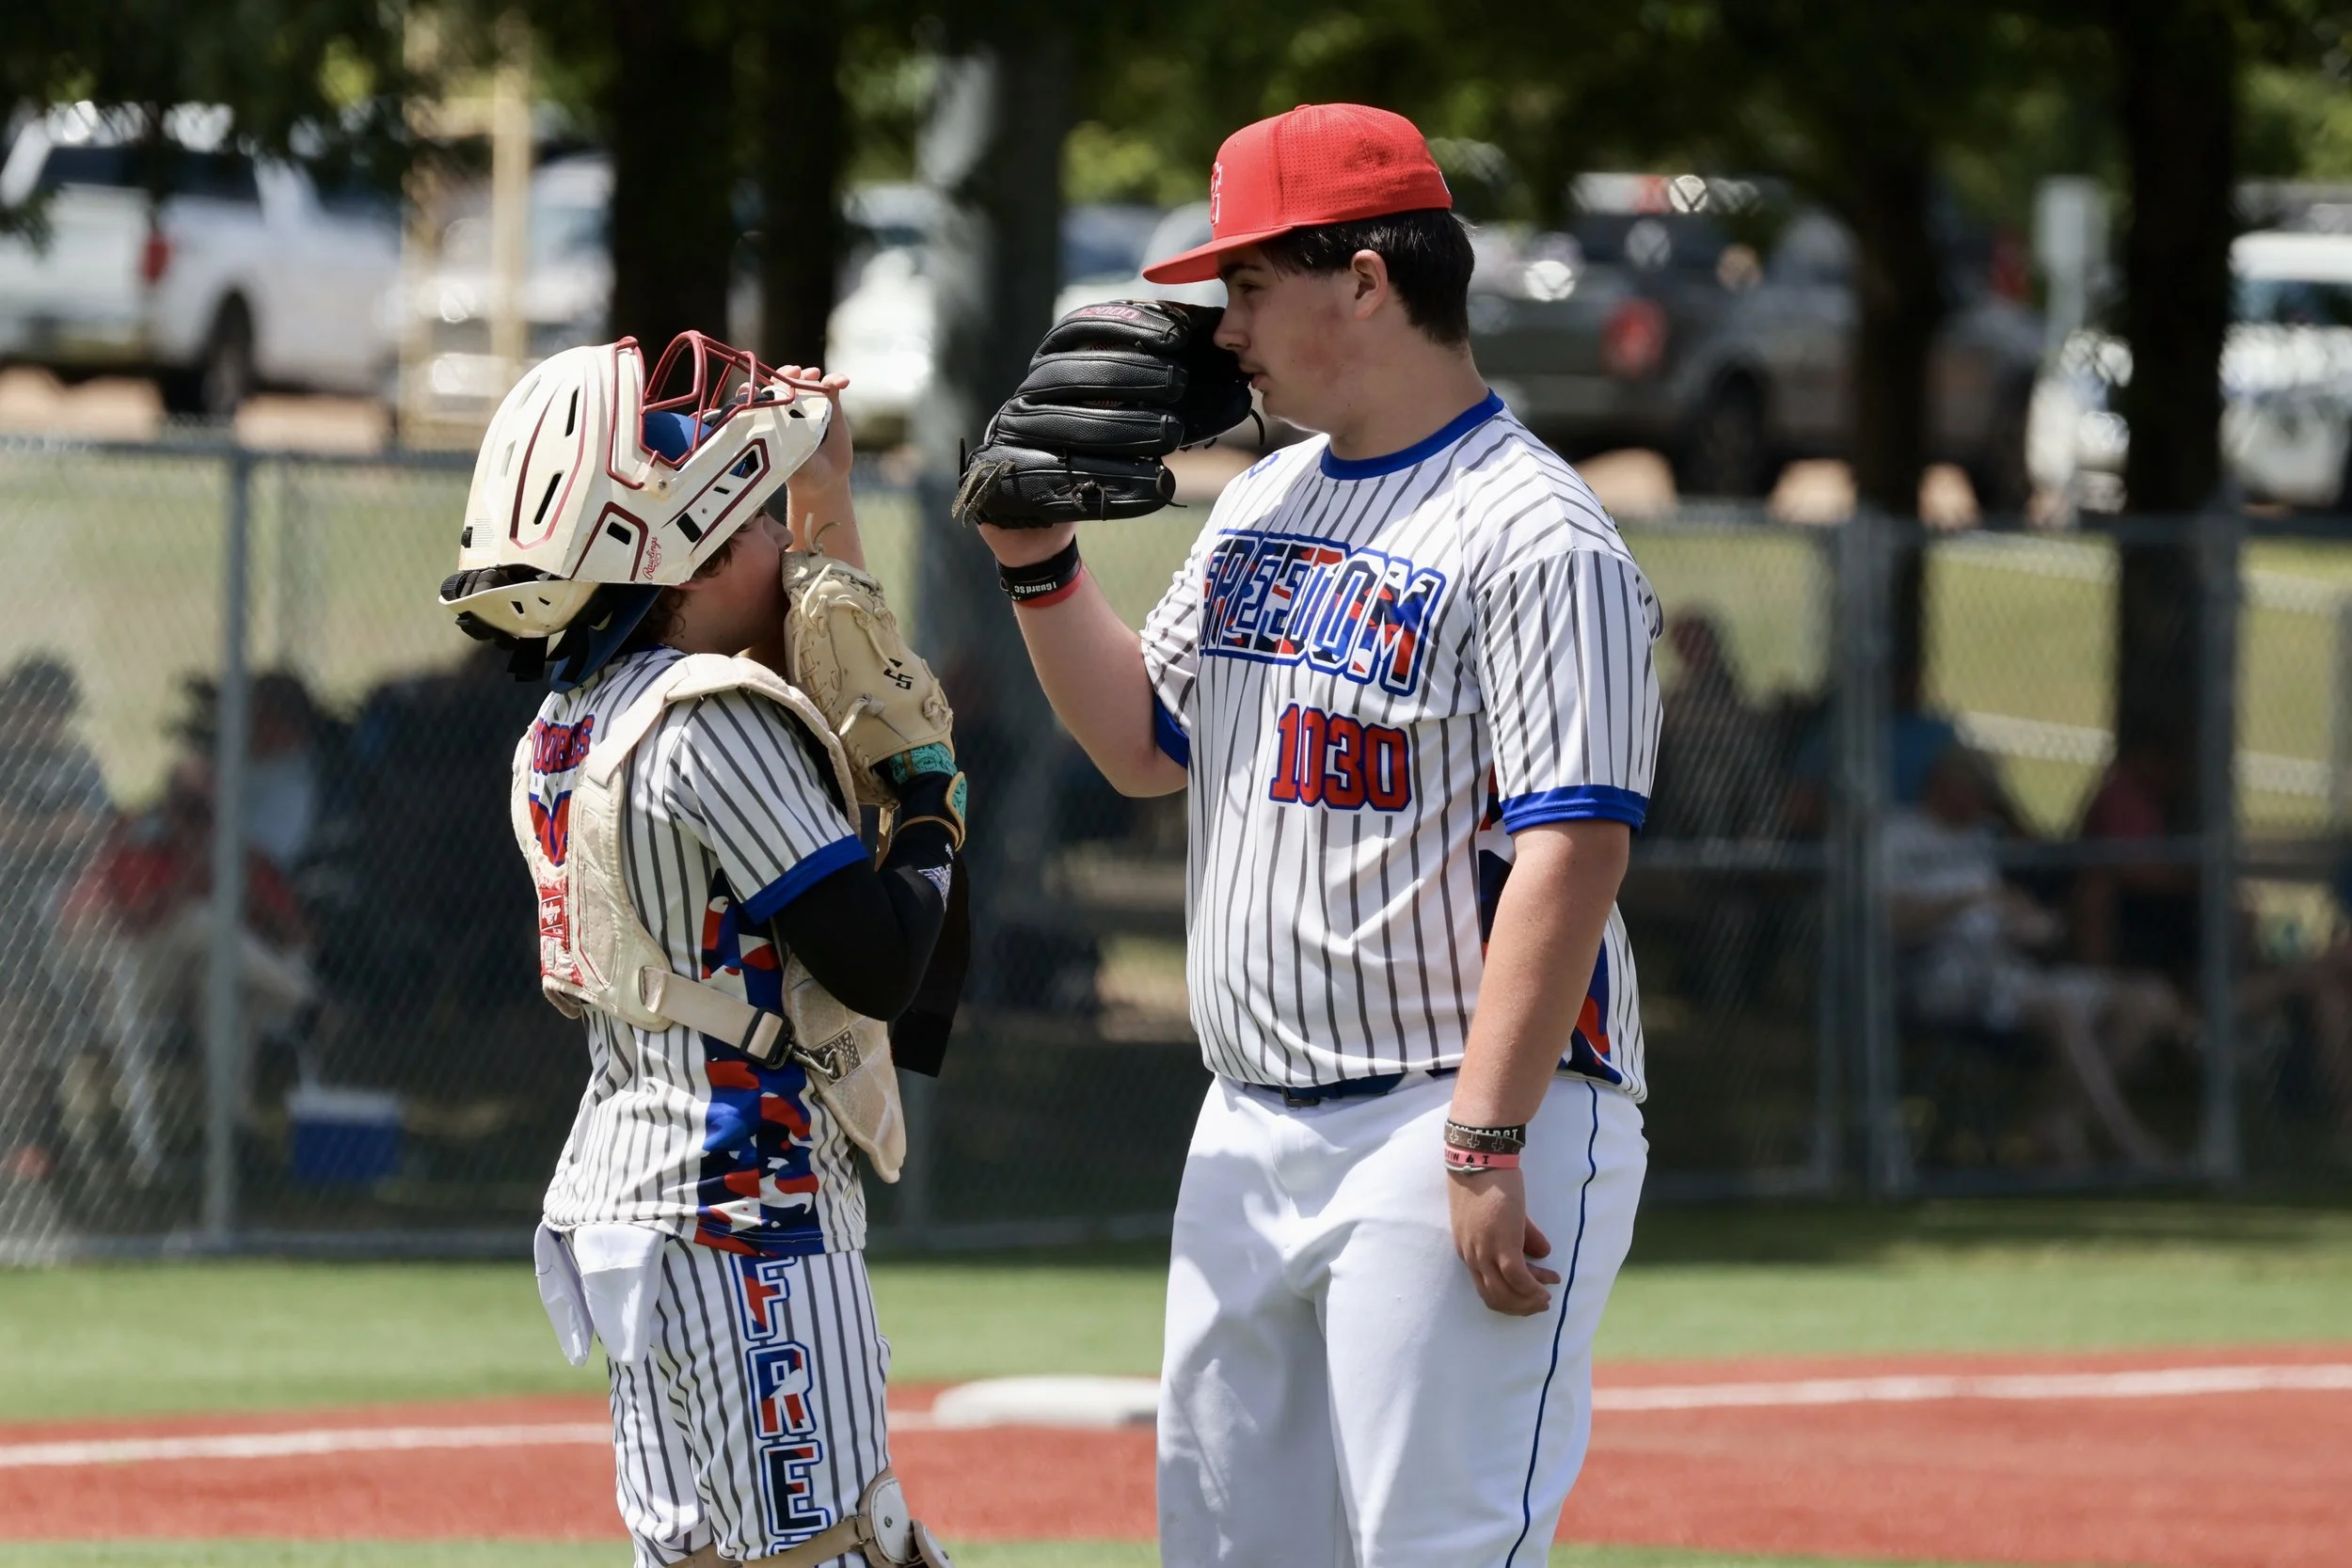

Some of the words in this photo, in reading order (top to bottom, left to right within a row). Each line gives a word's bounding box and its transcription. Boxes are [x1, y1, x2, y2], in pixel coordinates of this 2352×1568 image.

[643, 536, 662, 579] Rawlings
[1026, 583, 1053, 594] Guard
[1200, 529, 1446, 696] FREEDOM
[1268, 702, 1412, 812] 1030
